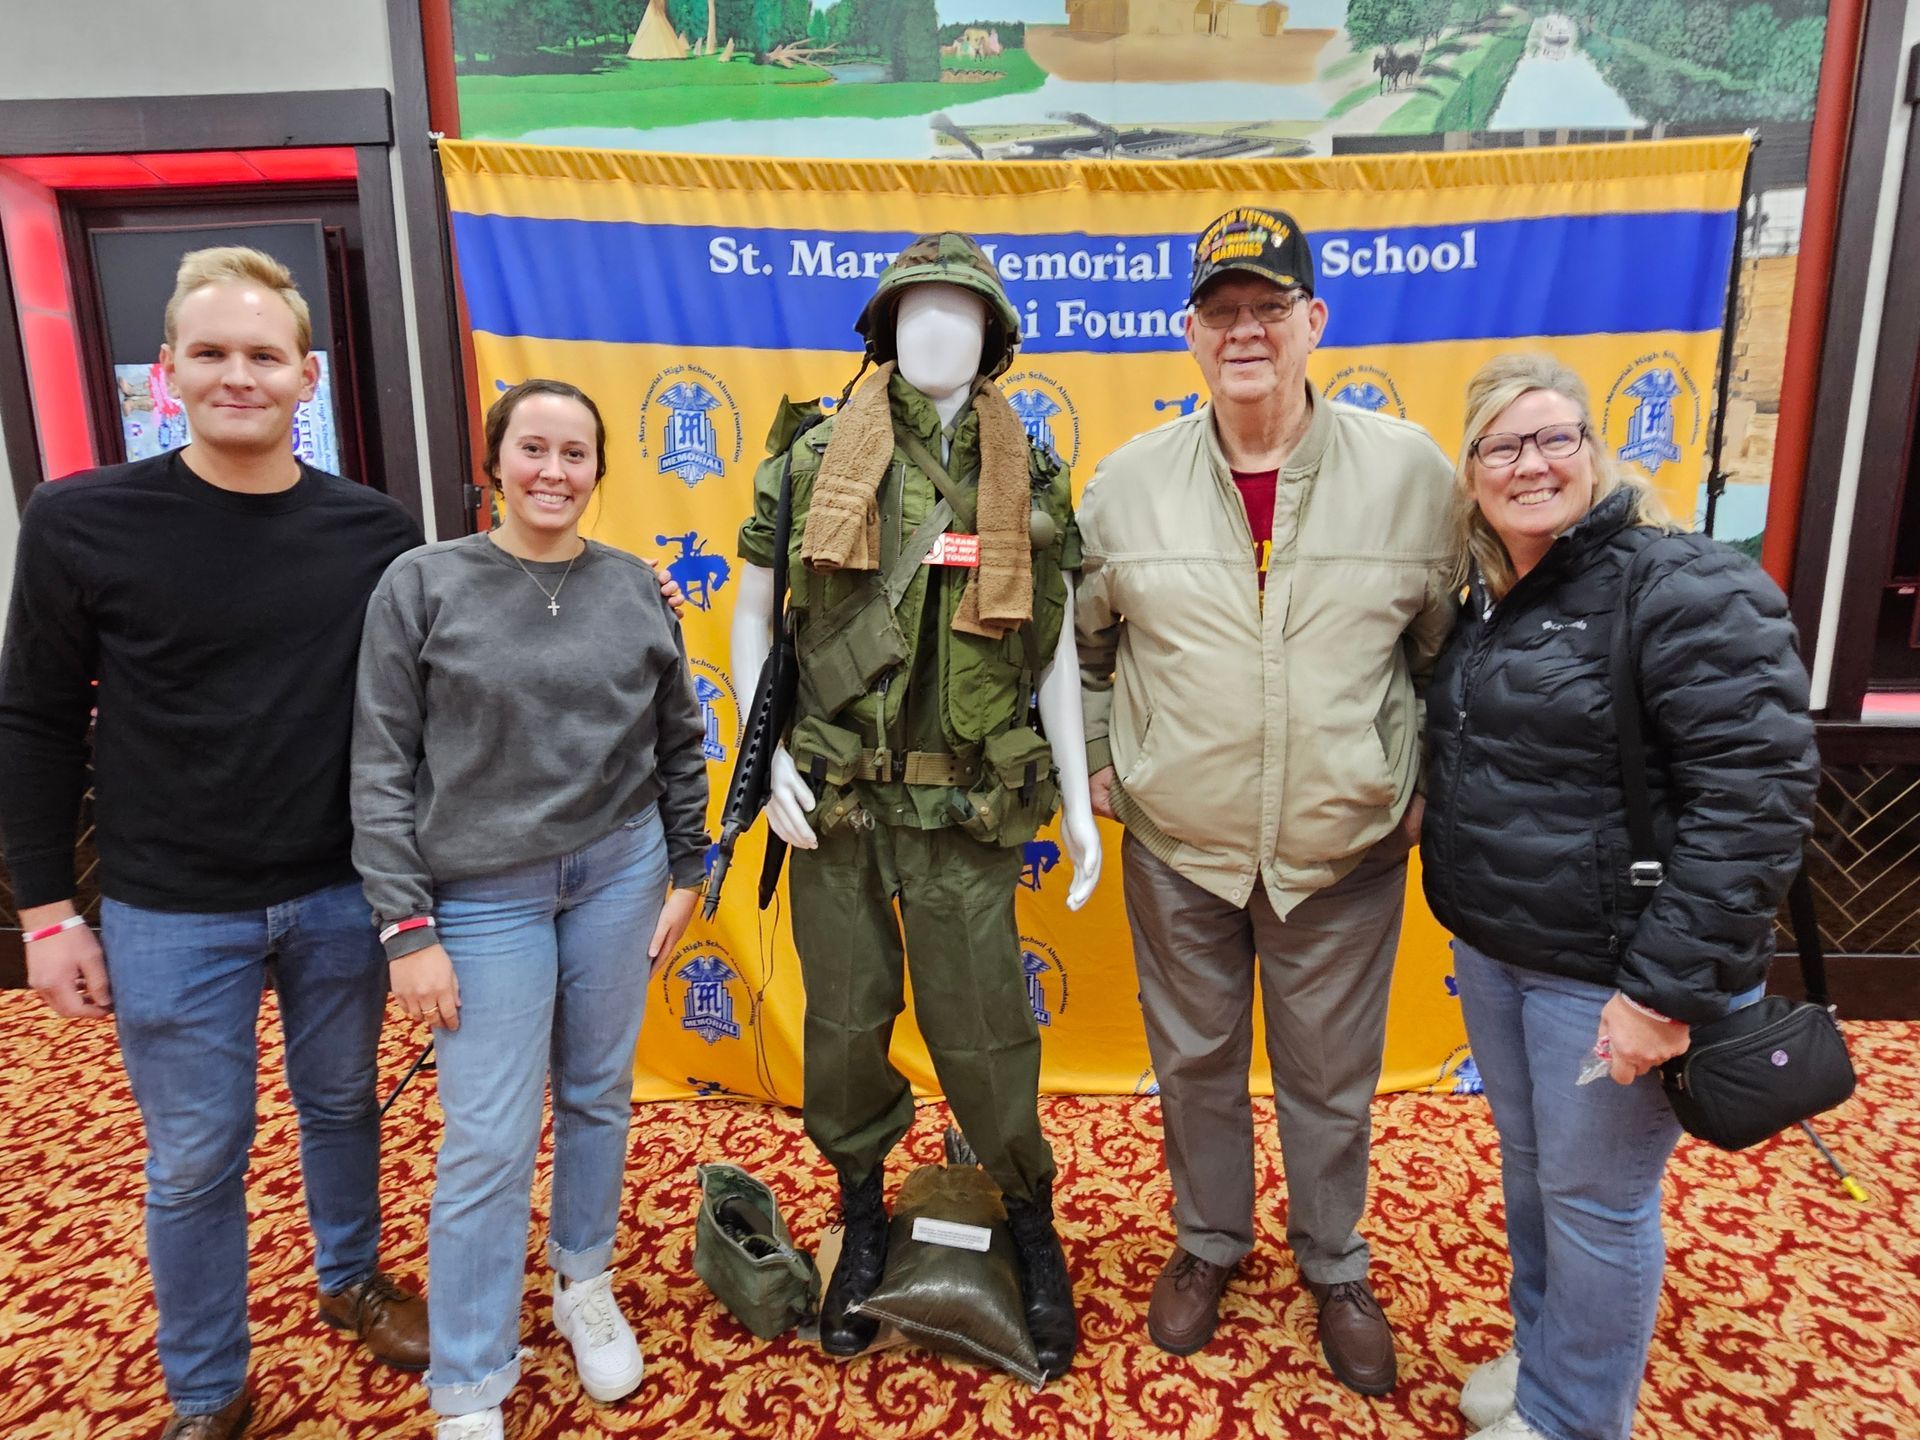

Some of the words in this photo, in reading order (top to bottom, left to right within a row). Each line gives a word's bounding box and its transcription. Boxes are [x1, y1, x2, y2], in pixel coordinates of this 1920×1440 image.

[709, 236, 774, 277] St.
[1321, 228, 1478, 279] School
[1006, 372, 1026, 384] High
[1029, 371, 1057, 386] School
[1056, 386, 1078, 415] Alumni
[640, 373, 663, 413] Memorial
[663, 365, 685, 376] High
[687, 364, 717, 381] School
[716, 380, 738, 410] Alumni
[733, 412, 743, 463] Foundation
[662, 451, 722, 469] MEMORIAL
[945, 536, 977, 546] PLEASE
[945, 554, 977, 562] TOUCH
[690, 657, 720, 673] School
[719, 672, 738, 700] Alumni
[682, 940, 703, 953] High
[1020, 935, 1047, 949] School
[1046, 947, 1064, 973] Alumni
[684, 1017, 738, 1035] MEMORIAL
